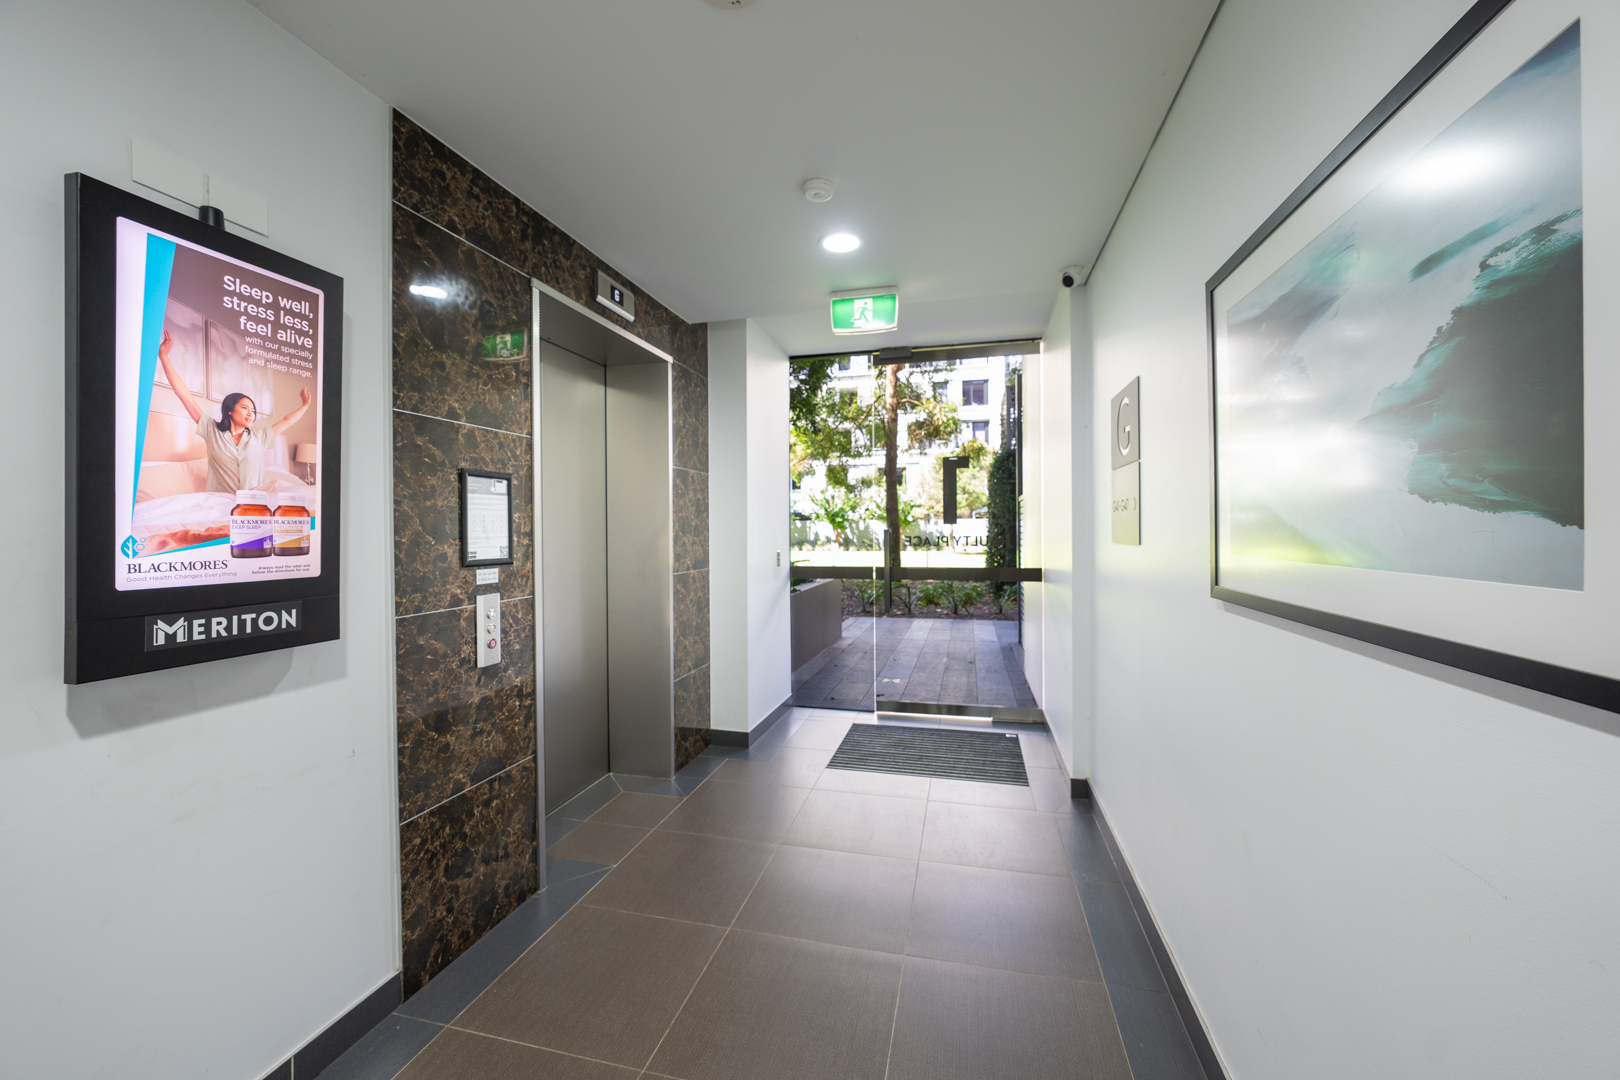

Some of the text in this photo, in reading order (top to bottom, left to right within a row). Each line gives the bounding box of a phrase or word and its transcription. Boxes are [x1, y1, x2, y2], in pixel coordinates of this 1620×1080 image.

[223, 275, 314, 318] Sleep well,
[223, 296, 313, 334] stress less,
[239, 315, 313, 348] feel alive
[244, 335, 313, 359] with our specially
[245, 345, 313, 368] formulated stress
[248, 356, 313, 378] and sleep range.
[1117, 397, 1131, 456] G
[126, 560, 228, 574] BLACKMORES
[173, 573, 203, 581] Changes
[153, 608, 298, 646] MERITON
